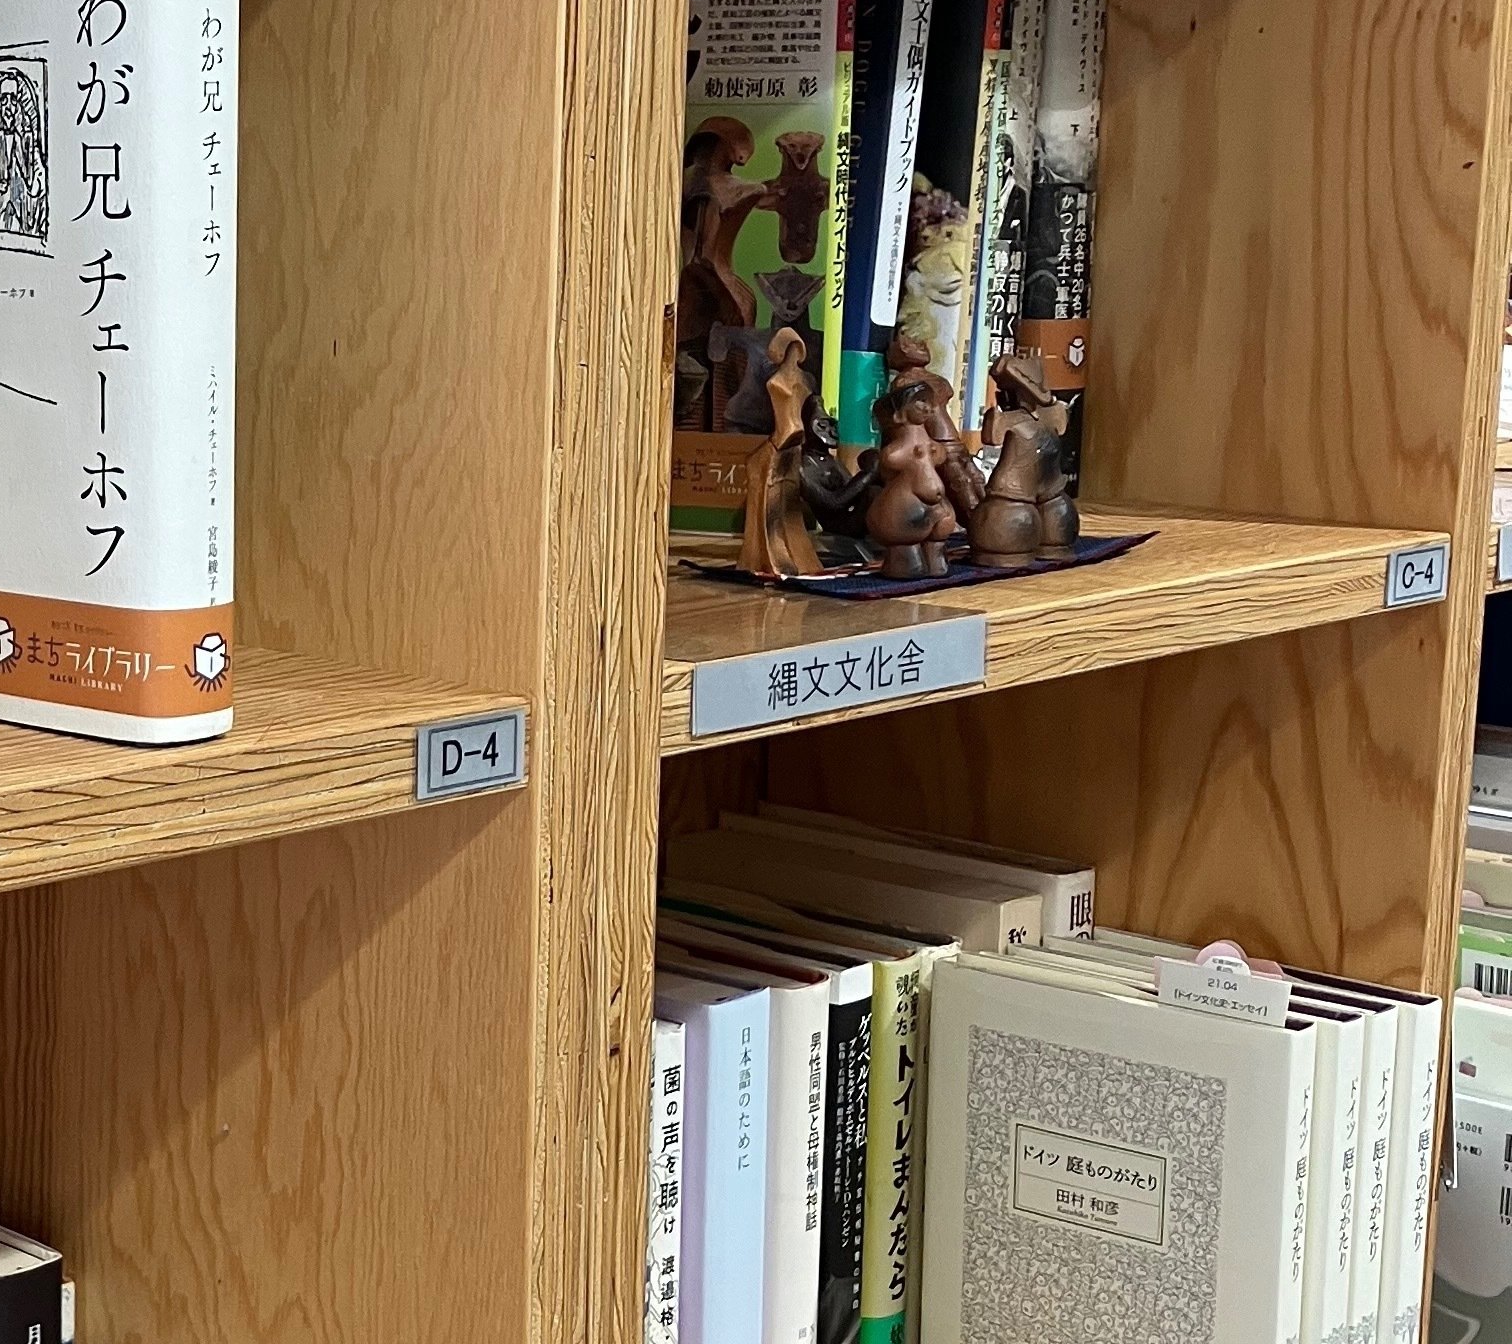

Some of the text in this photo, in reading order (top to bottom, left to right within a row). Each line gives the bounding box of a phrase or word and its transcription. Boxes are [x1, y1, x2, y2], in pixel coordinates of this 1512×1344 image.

[704, 75, 819, 99] 勅使河原 彰
[1008, 108, 1019, 121] 上
[1070, 124, 1081, 137] 下
[831, 131, 850, 309] 縄文時代ガイドブック
[206, 364, 220, 493] ミハイル・チェーホフ
[1402, 558, 1435, 589] C-4
[27, 632, 176, 683] まちライブラリー
[80, 679, 124, 693] LIBRARY
[767, 638, 926, 710] 縄文文化舎
[442, 731, 499, 776] D-4
[1207, 976, 1239, 992] 21.04
[737, 1026, 752, 1172] 日本語のために
[854, 1012, 873, 1149] ゲッベルスと私
[659, 1064, 682, 1236] 菌の声を聴け
[888, 1044, 916, 1301] トイレまんだら
[1022, 1144, 1158, 1192] ドイツ 庭ものがたり
[1291, 1084, 1312, 1283] ドイツ 庭ものがたり
[1338, 1076, 1359, 1273] ドイツ 庭ものがたり
[1368, 1067, 1392, 1263] ドイツ 庭ものがたり
[1412, 1058, 1437, 1253] ドイツ 庭ものがたり
[1056, 1188, 1120, 1216] 田村 和彦
